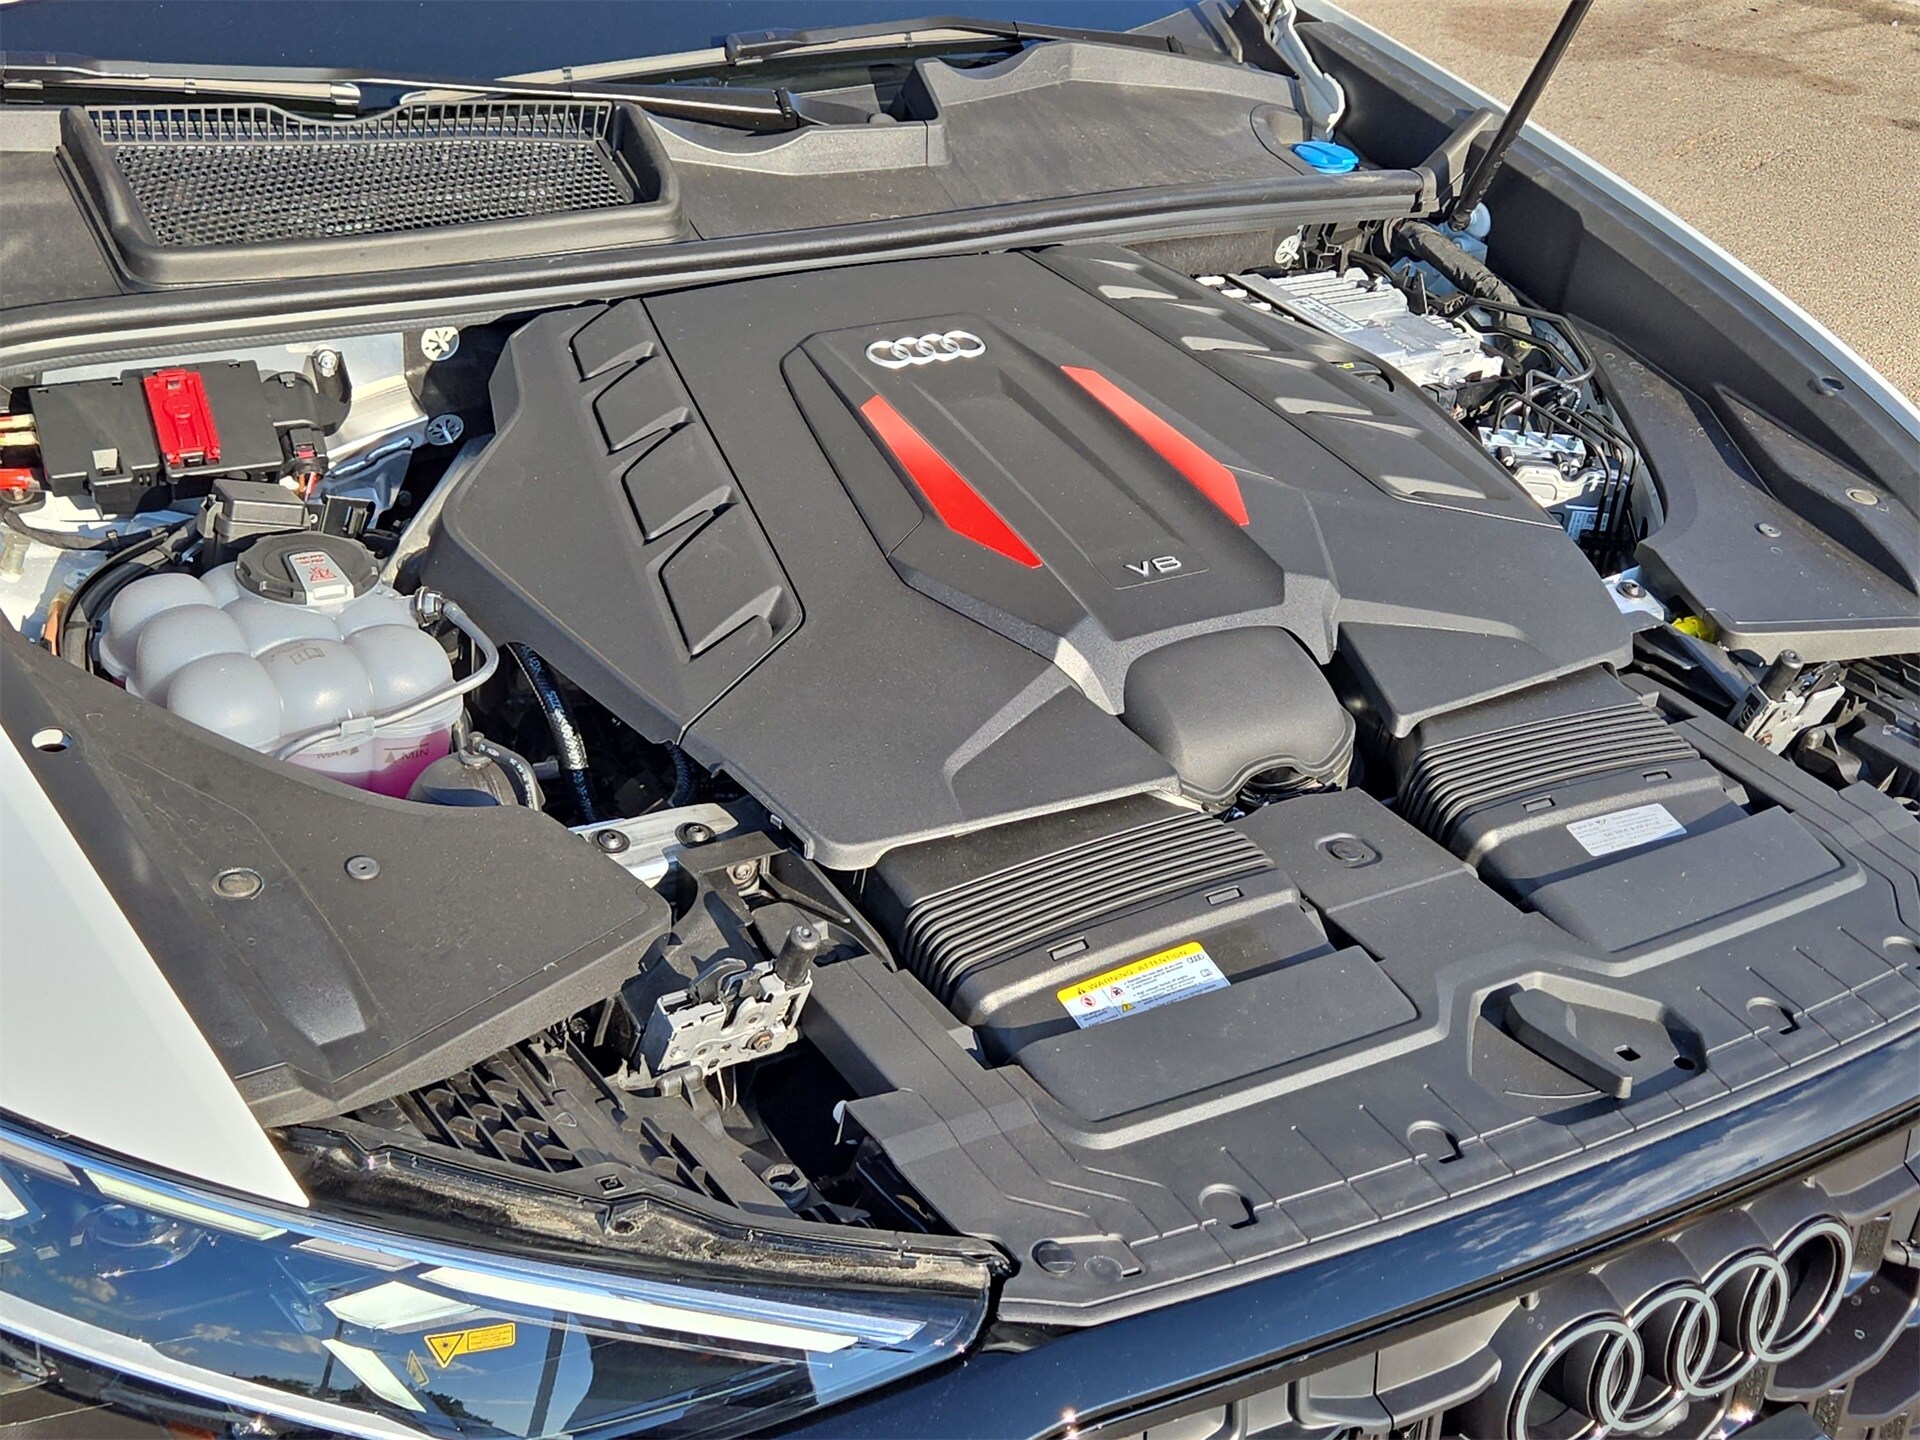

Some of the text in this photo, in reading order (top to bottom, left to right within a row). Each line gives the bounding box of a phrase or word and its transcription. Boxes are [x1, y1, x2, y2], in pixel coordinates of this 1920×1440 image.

[401, 748, 430, 761] MIN
[1087, 969, 1134, 991] WARNING
[1138, 950, 1188, 972] ATTENTION
